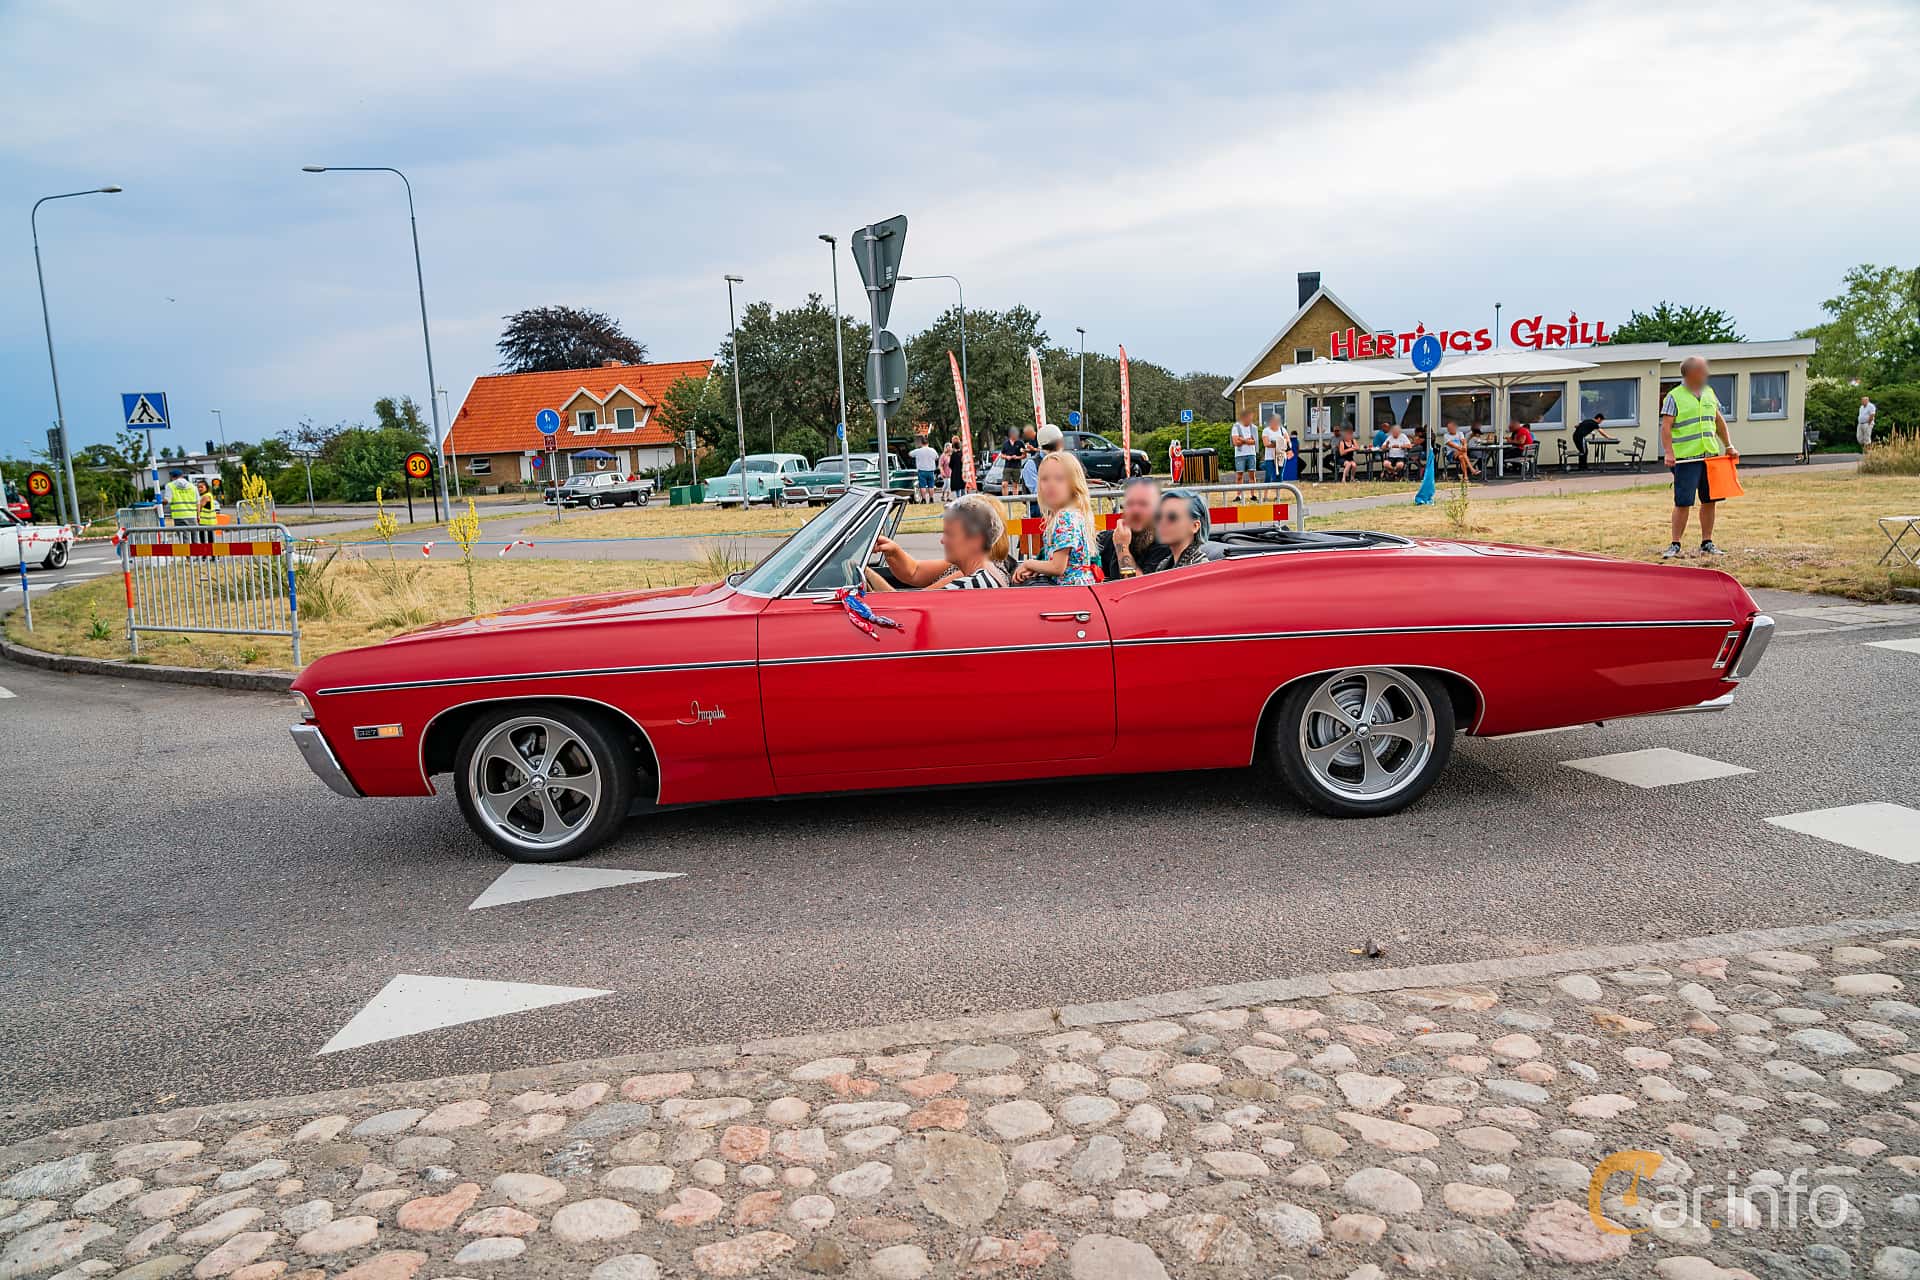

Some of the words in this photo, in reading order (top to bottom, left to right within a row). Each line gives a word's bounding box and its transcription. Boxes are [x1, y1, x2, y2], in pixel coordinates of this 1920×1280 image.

[1331, 322, 1492, 359] HERTGS
[1510, 311, 1610, 350] GRILL
[411, 460, 426, 471] 30
[32, 478, 47, 489] 30
[677, 700, 726, 726] Impala
